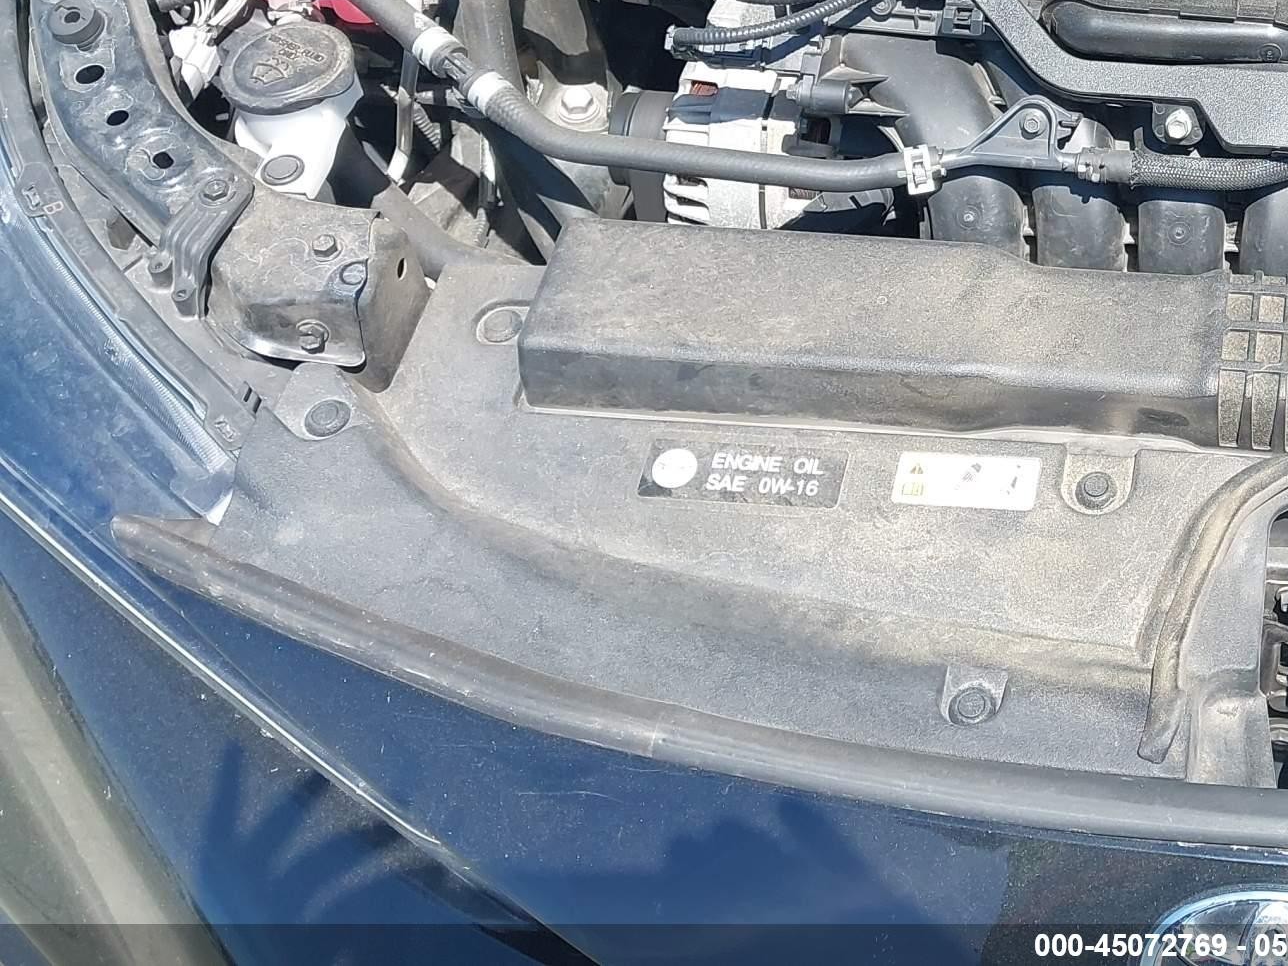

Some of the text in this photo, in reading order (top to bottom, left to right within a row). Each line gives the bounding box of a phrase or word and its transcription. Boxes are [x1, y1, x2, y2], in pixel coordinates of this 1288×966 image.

[711, 452, 783, 473] ENGINE
[793, 457, 824, 476] OIL
[705, 473, 820, 497] SAE 0W-16
